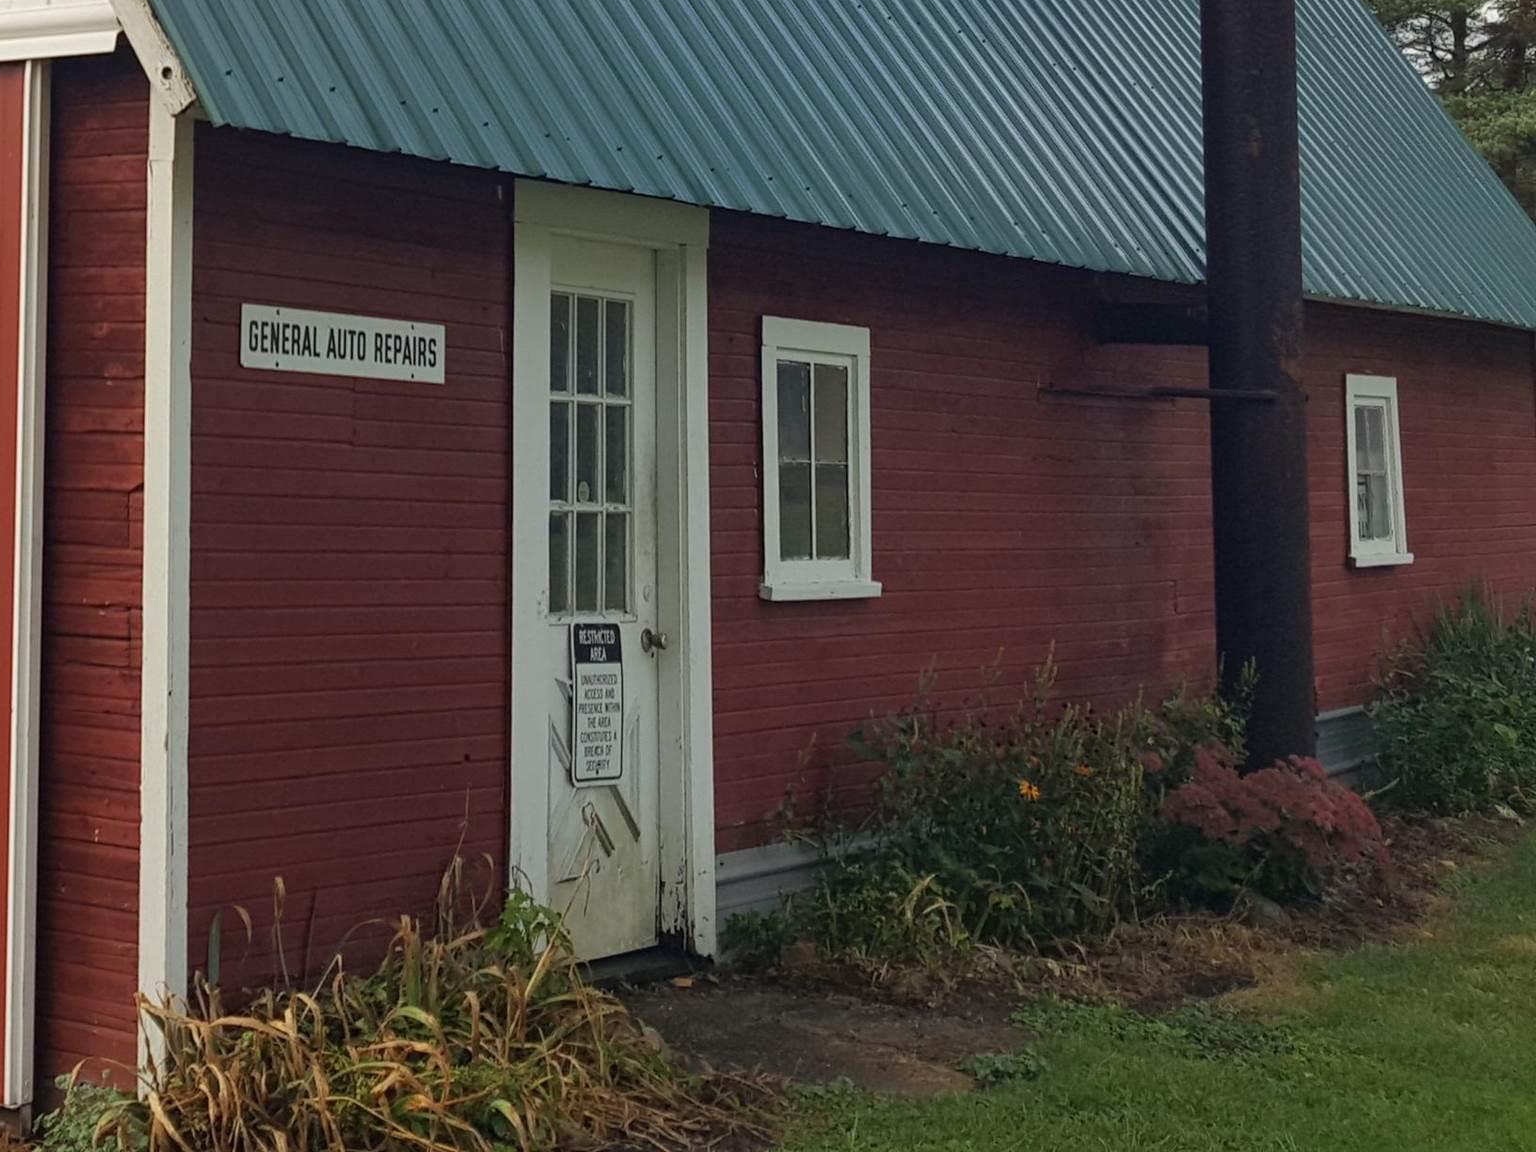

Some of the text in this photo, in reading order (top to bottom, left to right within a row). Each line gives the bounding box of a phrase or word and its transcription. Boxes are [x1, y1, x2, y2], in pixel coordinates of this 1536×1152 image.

[249, 320, 437, 368] GENERAL AUTO REPAIRS
[579, 629, 615, 645] RESTRICTED
[590, 646, 607, 661] AREA
[581, 674, 617, 686] UNAUTHORIZED
[584, 687, 615, 700] ACCESS AND
[579, 702, 621, 714] PRESENCE WITHIN
[587, 715, 611, 728] THE AREA
[580, 731, 612, 743] CONSTITUTES
[584, 744, 612, 757] BREACH OF
[586, 759, 610, 772] SECURITY
